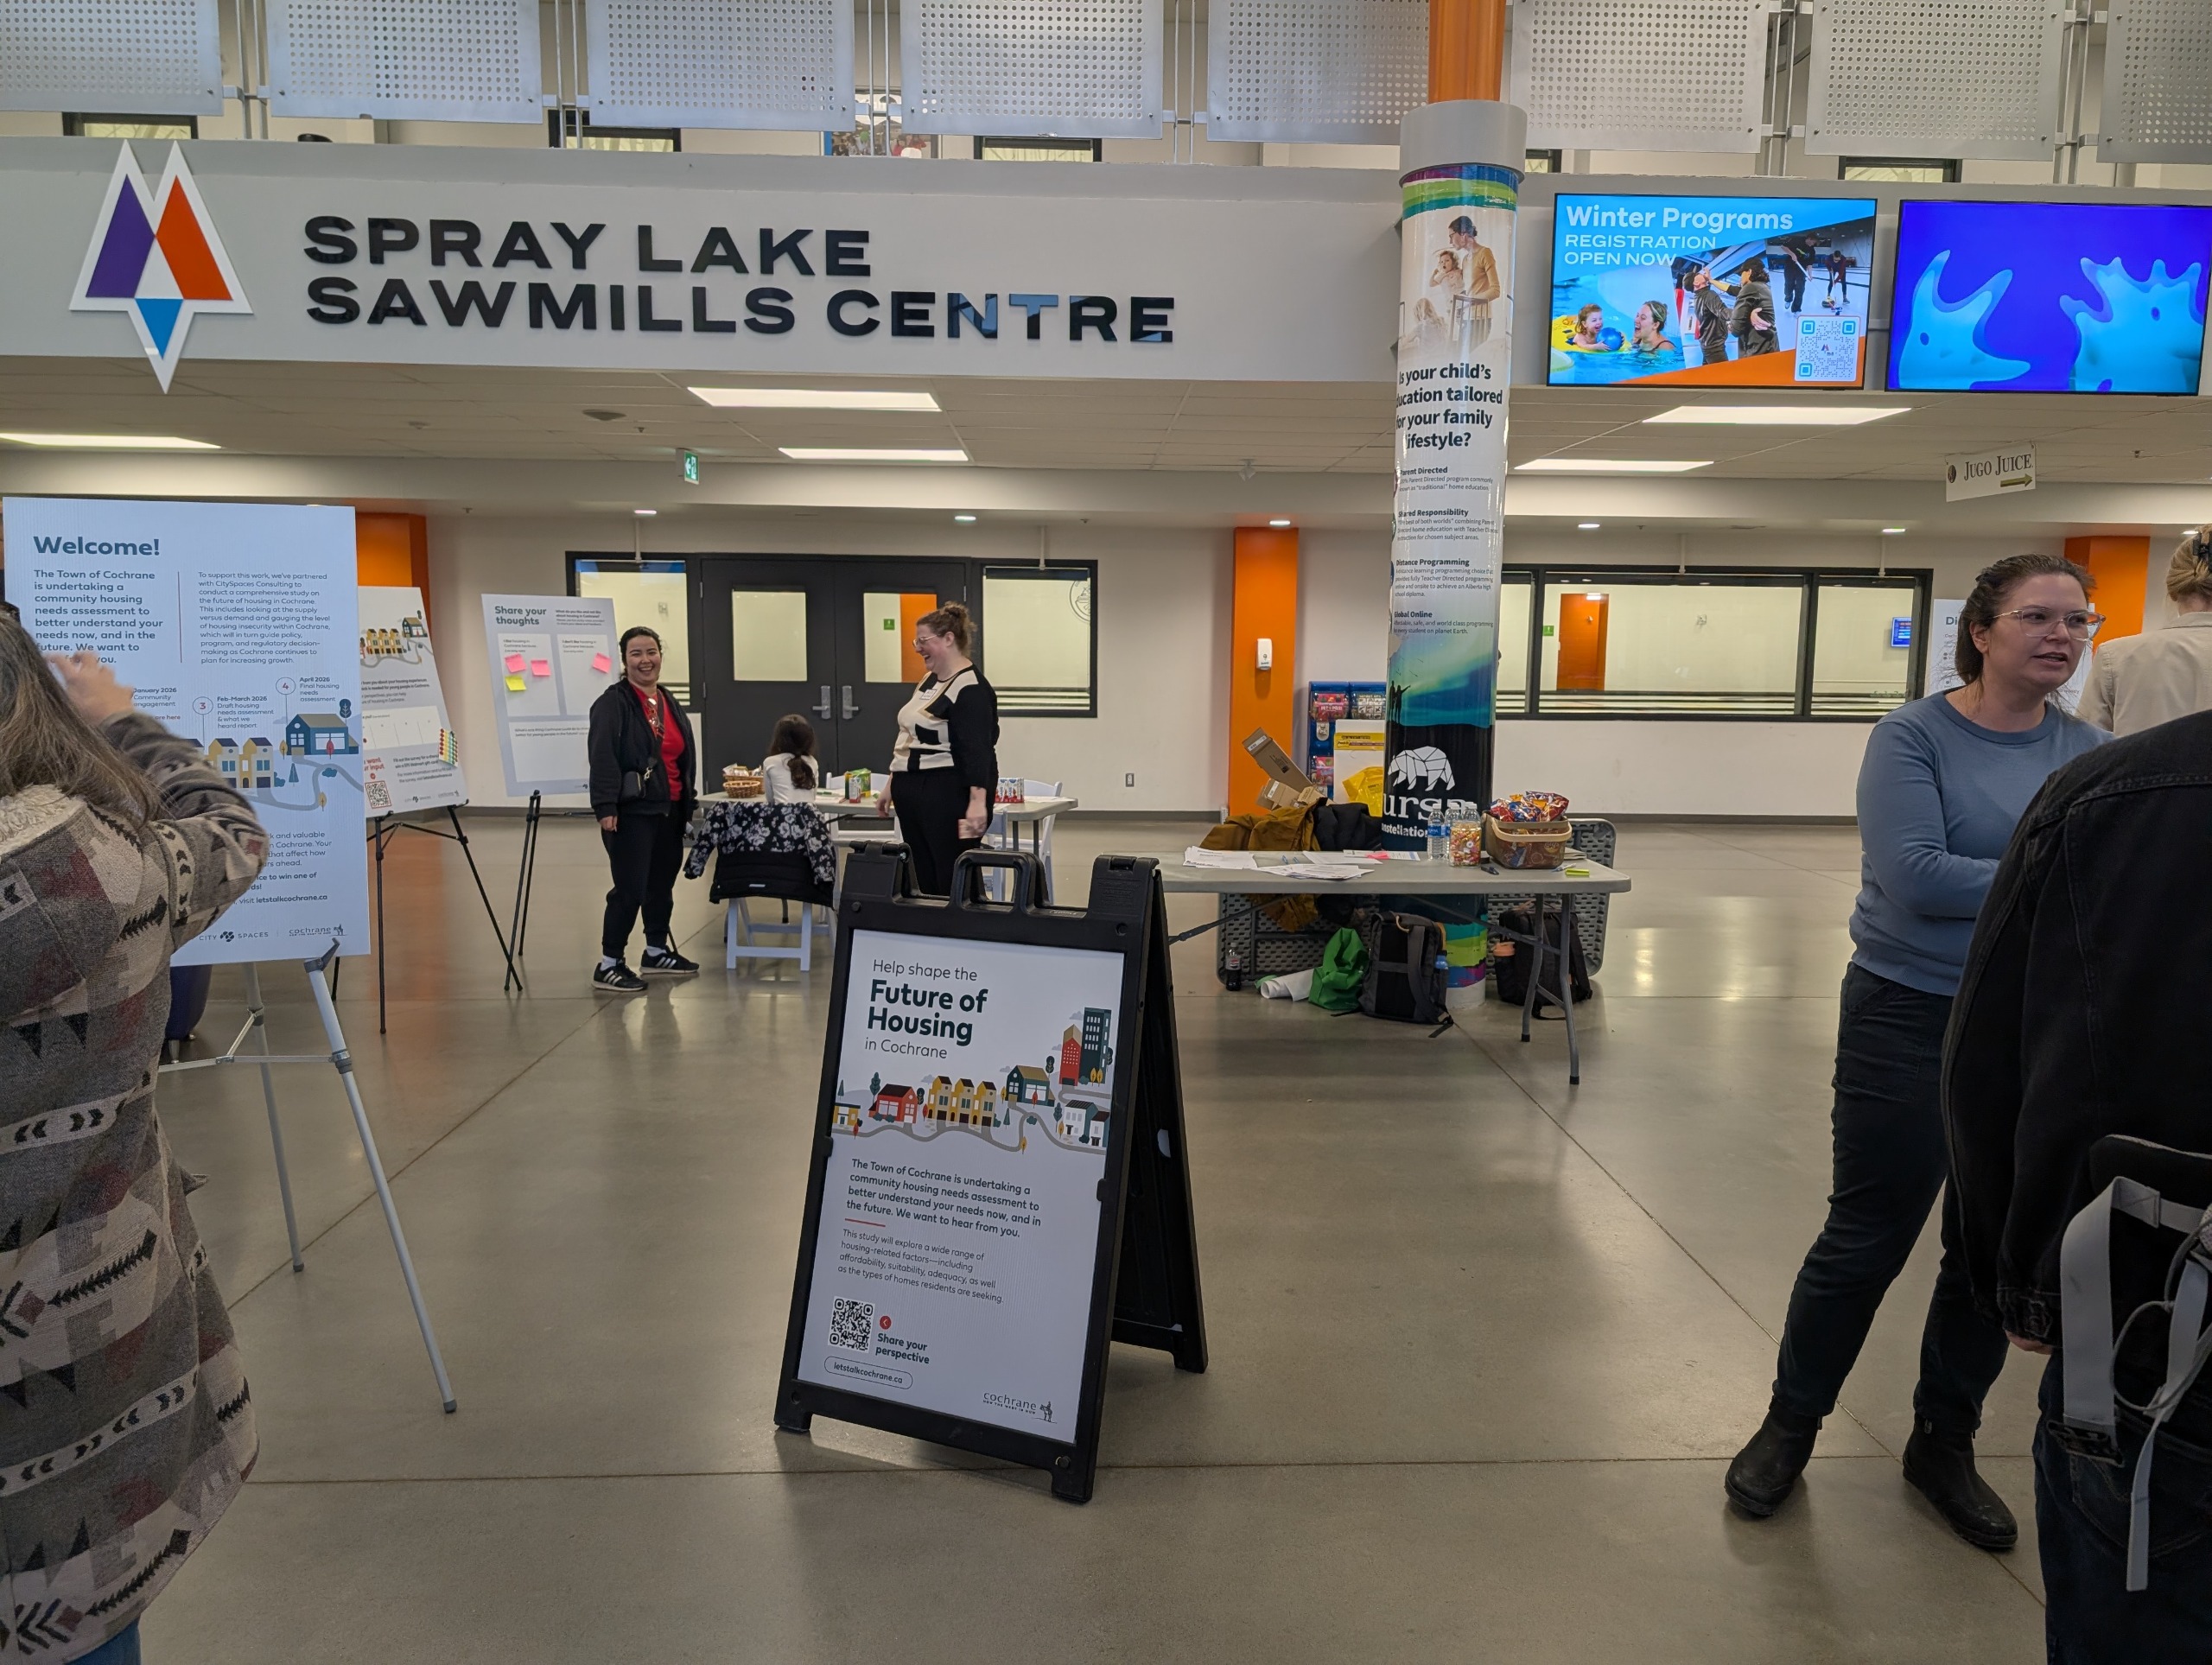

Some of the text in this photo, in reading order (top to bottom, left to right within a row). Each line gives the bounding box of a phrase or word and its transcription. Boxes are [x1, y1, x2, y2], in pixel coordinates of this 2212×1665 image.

[1567, 204, 1793, 233] Winter Programs
[305, 216, 870, 276] SPRAY LAKE
[1566, 235, 1716, 249] REGISTRATION
[1564, 251, 1676, 266] OPEN NOW
[305, 276, 1174, 343] SAWMILLS CENTRE
[1406, 366, 1437, 385] your
[1446, 385, 1503, 404] tailored
[1408, 412, 1440, 429] your
[1444, 409, 1492, 429] family
[1964, 454, 2032, 480] JUGO JUICE
[1417, 508, 1469, 518] Responsibility
[34, 537, 159, 556] Welcome!
[1420, 558, 1470, 567] Programming
[46, 582, 113, 593] undertaking
[35, 594, 142, 605] community housing
[495, 606, 523, 614] Share
[496, 616, 539, 626] thoughts
[873, 959, 977, 981] Help shape the
[870, 979, 988, 1014] Future of
[868, 1007, 973, 1046] Housing
[865, 1037, 947, 1059] in Cochrane
[852, 1159, 868, 1169] The
[871, 1161, 893, 1173] Town
[896, 1166, 906, 1175] of
[908, 1167, 951, 1182] Cochrane
[954, 1174, 961, 1184] is
[964, 1178, 1021, 1195] undertaking
[850, 1175, 1039, 1211] community housing needs assessment to
[849, 1185, 1040, 1226] better understand your needs now, and in
[847, 1199, 1020, 1237] the future. We want to hear from you.
[842, 1241, 900, 1258] housing-related
[843, 1229, 857, 1238] This
[859, 1233, 880, 1243] study
[895, 1240, 923, 1249] explore
[931, 1245, 950, 1255] wide
[951, 1250, 975, 1260] range
[840, 1254, 886, 1269] affordability,
[888, 1263, 925, 1277] suitability,
[928, 1270, 967, 1284] adequacy,
[849, 1267, 861, 1275] the
[862, 1270, 882, 1279] types
[893, 1274, 918, 1286] homes
[921, 1282, 956, 1293] residents
[957, 1286, 970, 1296] are
[972, 1291, 1003, 1304] seeking.
[878, 1332, 928, 1351] Share your
[875, 1345, 930, 1364] perspective
[834, 1362, 902, 1384] letstalkcochrane.ca
[983, 1393, 1037, 1410] cochrane
